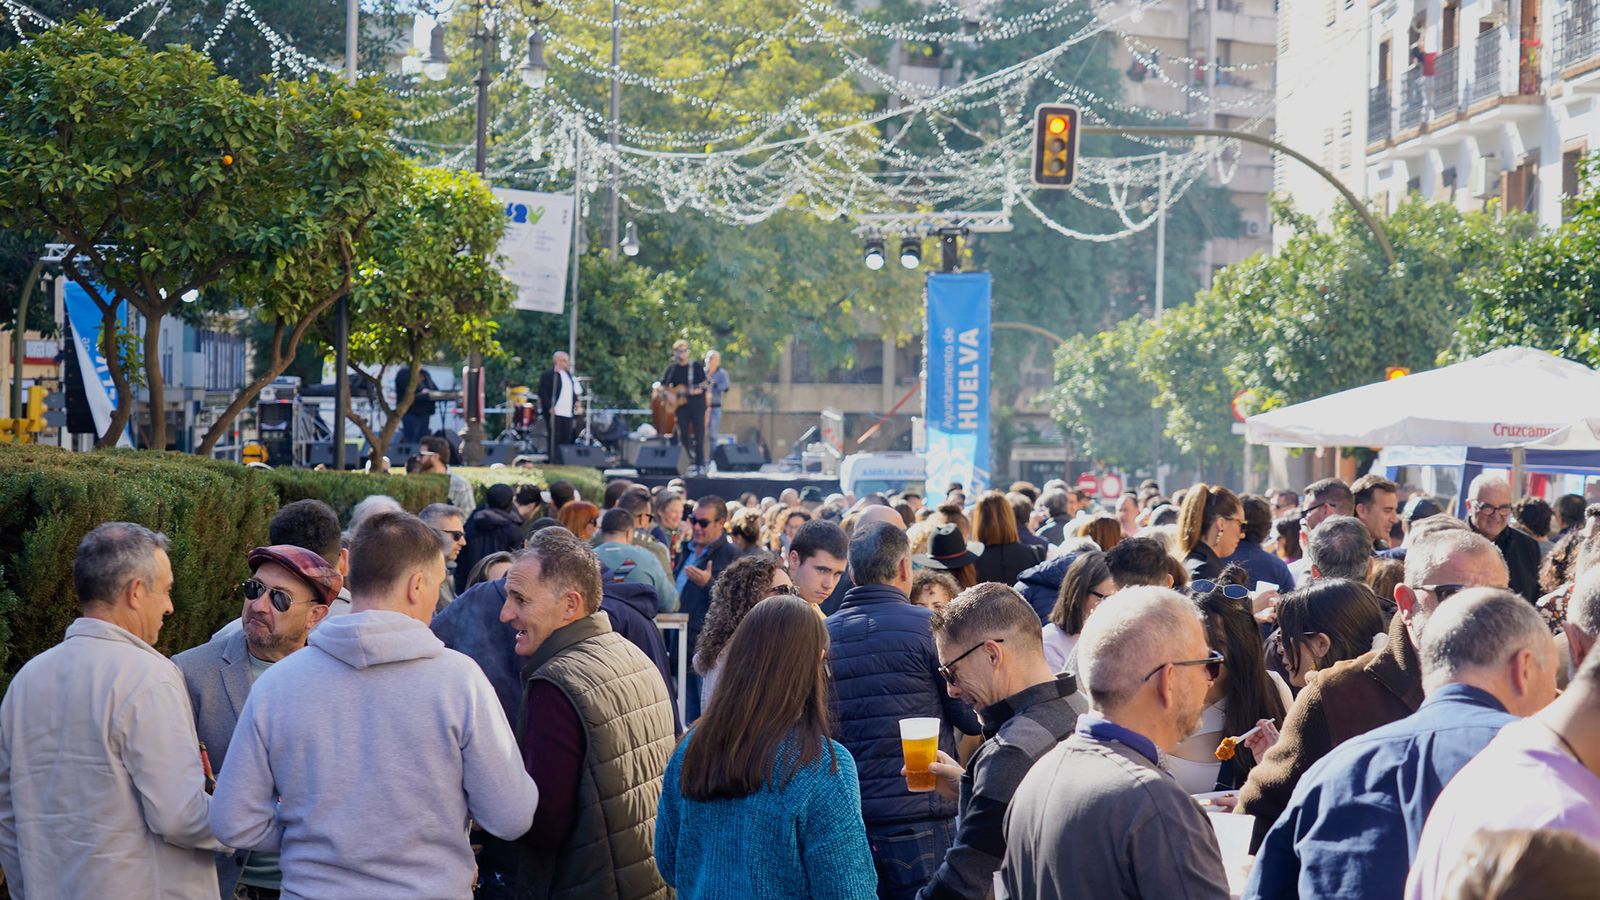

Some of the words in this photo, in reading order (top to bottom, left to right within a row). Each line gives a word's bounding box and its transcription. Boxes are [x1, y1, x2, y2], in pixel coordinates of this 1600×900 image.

[943, 327, 954, 343] de
[944, 345, 956, 429] Ayuntamiento
[958, 328, 979, 429] HUELVA
